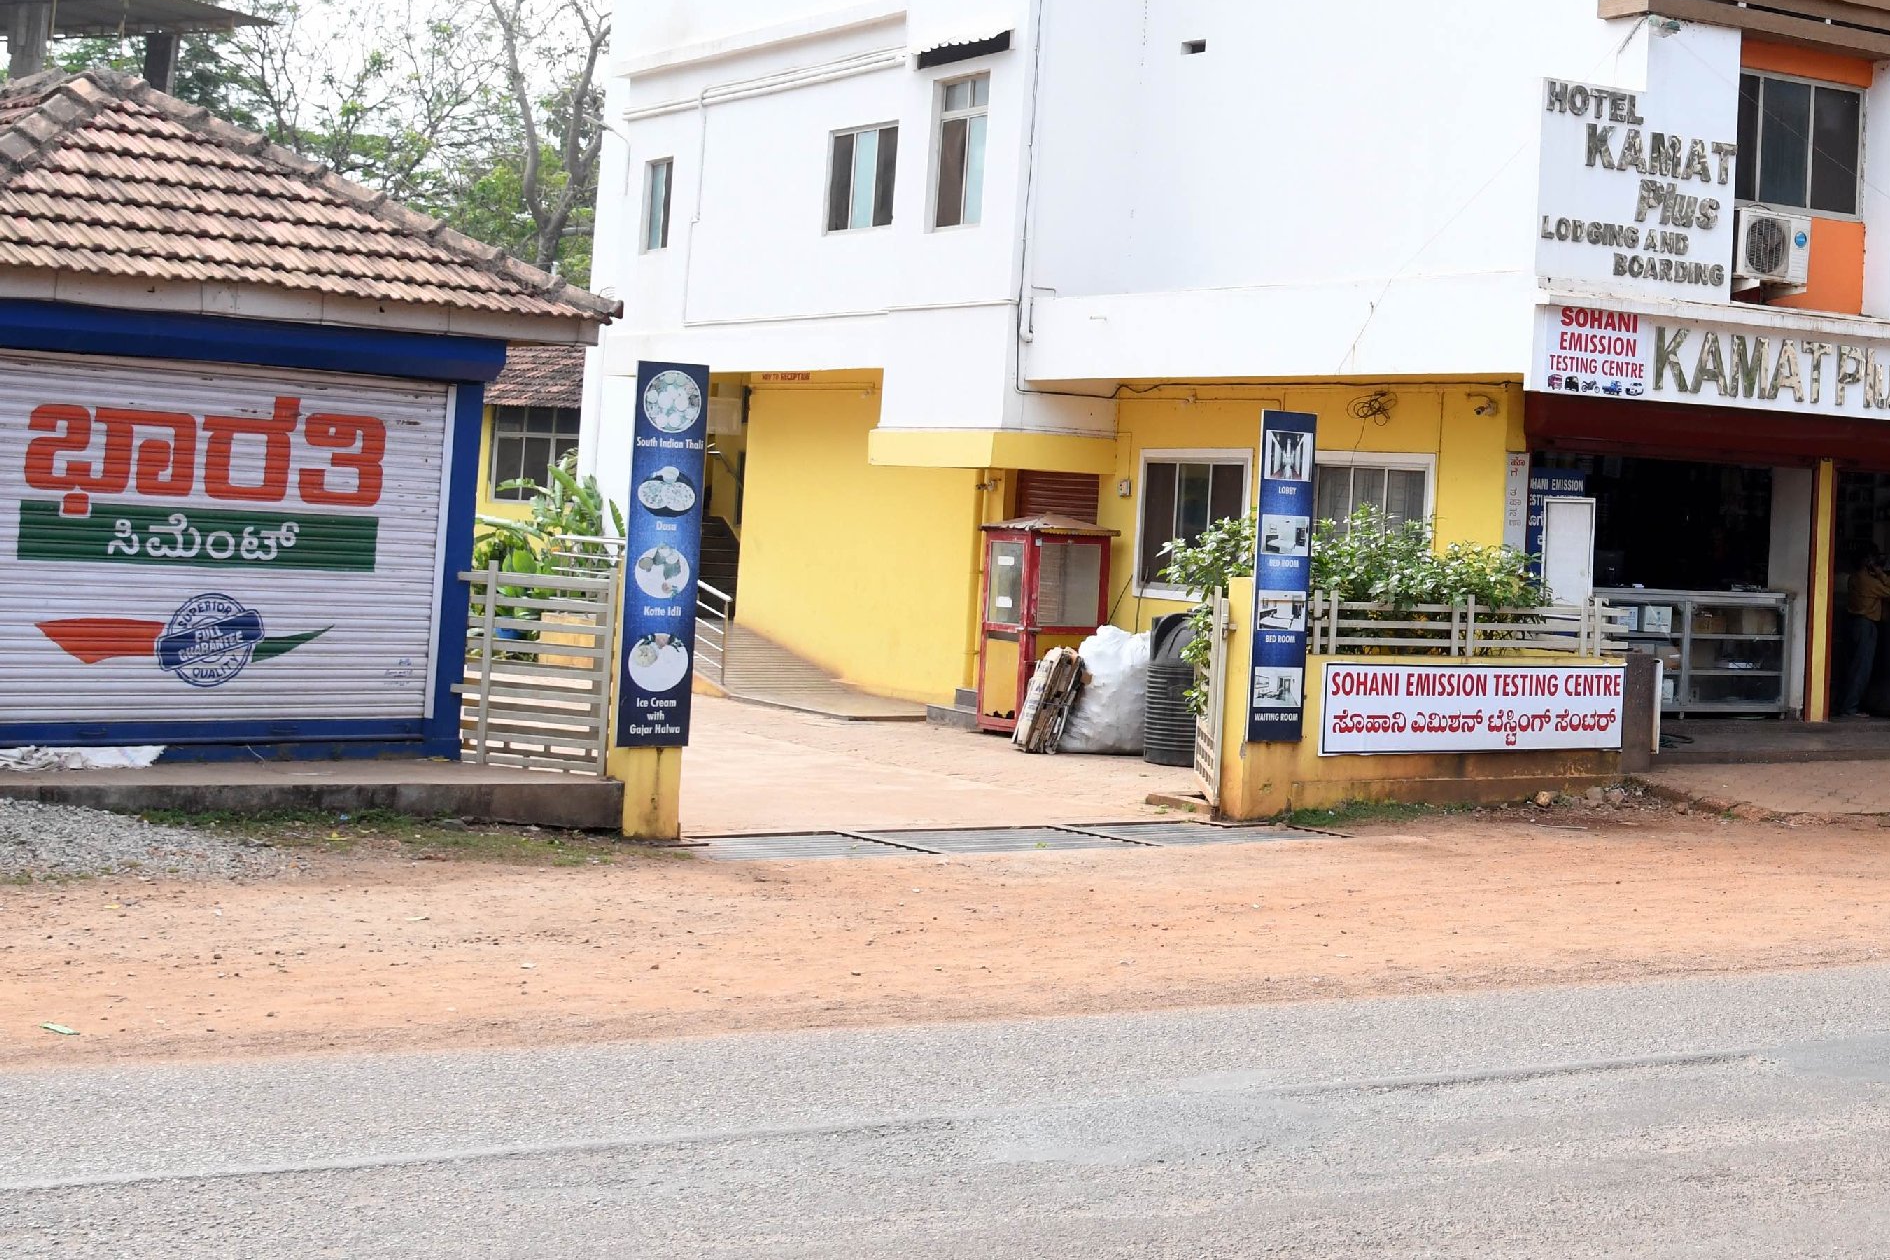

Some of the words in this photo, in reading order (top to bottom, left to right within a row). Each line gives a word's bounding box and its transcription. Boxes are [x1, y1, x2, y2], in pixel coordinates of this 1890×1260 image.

[1546, 80, 1644, 125] HOTEL
[1585, 123, 1738, 185] KAMAT
[1540, 215, 1639, 248] LODGING
[1643, 229, 1689, 255] AND
[1613, 252, 1725, 286] BOARDING
[1560, 306, 1638, 334] SOHANI
[1559, 331, 1637, 357] EMISSION
[1549, 354, 1598, 375] TESTING
[1601, 359, 1645, 379] CENTRE
[1653, 326, 1832, 404] KAMAT
[24, 396, 386, 515] ಭಾರತಿ
[636, 436, 658, 448] South
[659, 437, 684, 449] Indian
[685, 439, 704, 450] Thali
[1278, 485, 1297, 495] LOBBY
[1551, 478, 1584, 491] EMISSION
[108, 513, 300, 561] ಸಿಮೆಂಟ್
[178, 600, 232, 629] SUPERIOR
[667, 606, 682, 617] Idli
[195, 625, 224, 642] FULL
[1265, 634, 1277, 643] BED
[1278, 635, 1296, 643] ROOM
[178, 631, 244, 662] GUARANTEE
[192, 654, 239, 678] QUALITY
[1331, 672, 1400, 697] SOHANI
[1405, 672, 1487, 697] EMISSION
[1493, 673, 1559, 697] TESTING
[1564, 673, 1621, 697] CENTRE
[636, 697, 649, 708] Ice
[650, 697, 677, 708] Cream
[647, 710, 665, 721] with
[1254, 713, 1279, 721] WAITING
[1280, 713, 1299, 721] ROOM
[629, 724, 653, 737] Gajar
[654, 723, 681, 734] Halwa
